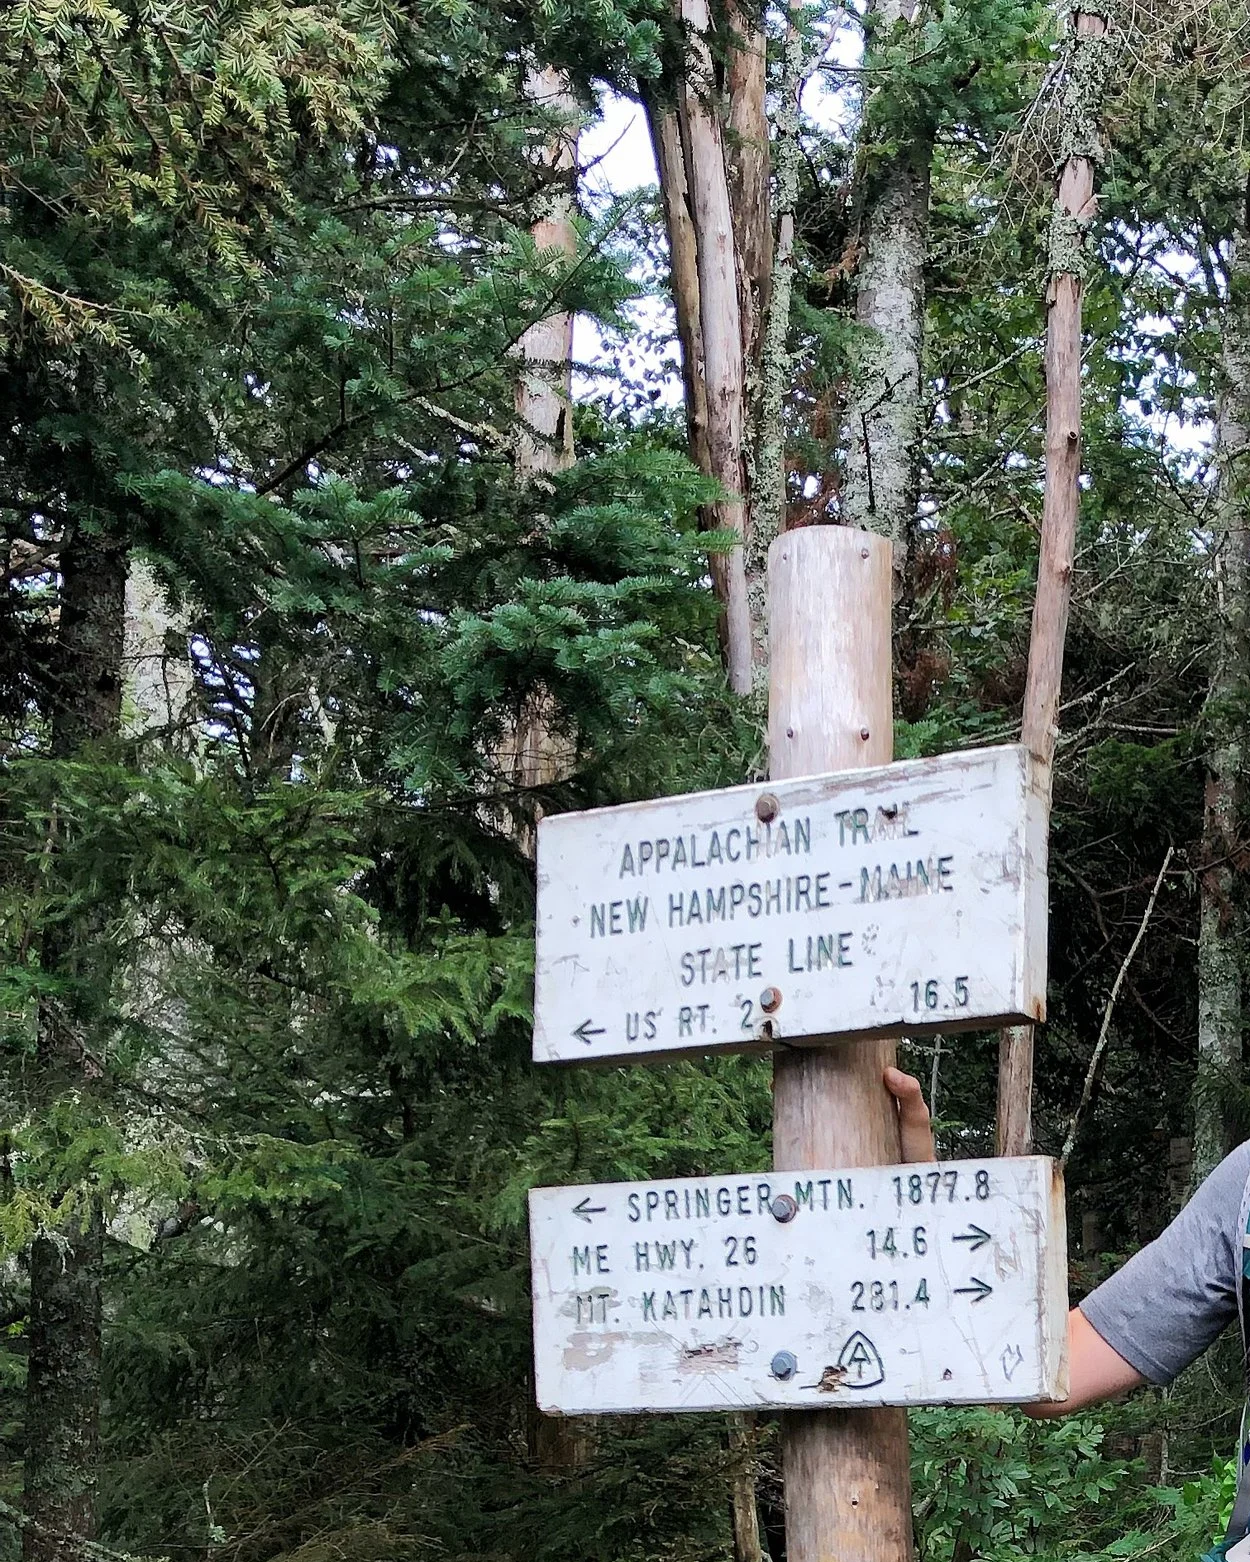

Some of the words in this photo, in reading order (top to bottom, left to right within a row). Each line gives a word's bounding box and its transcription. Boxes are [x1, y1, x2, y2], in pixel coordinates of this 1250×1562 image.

[618, 818, 812, 880] APPALACHIAN
[590, 896, 649, 938] NEW
[680, 942, 763, 987] STATE
[788, 932, 855, 974] LINE
[910, 976, 969, 1013] 16.5
[625, 1010, 657, 1042] US
[678, 1004, 718, 1038] RT.
[627, 1183, 773, 1223] SPRINGER
[794, 1178, 865, 1212] MTN.
[891, 1169, 990, 1206] 1877.8
[571, 1244, 611, 1276] ME
[635, 1238, 704, 1272] HWY.
[724, 1236, 757, 1267] 26
[866, 1226, 928, 1260] 14.6
[576, 1293, 620, 1324] MT.
[642, 1285, 786, 1323] KATAHDIN
